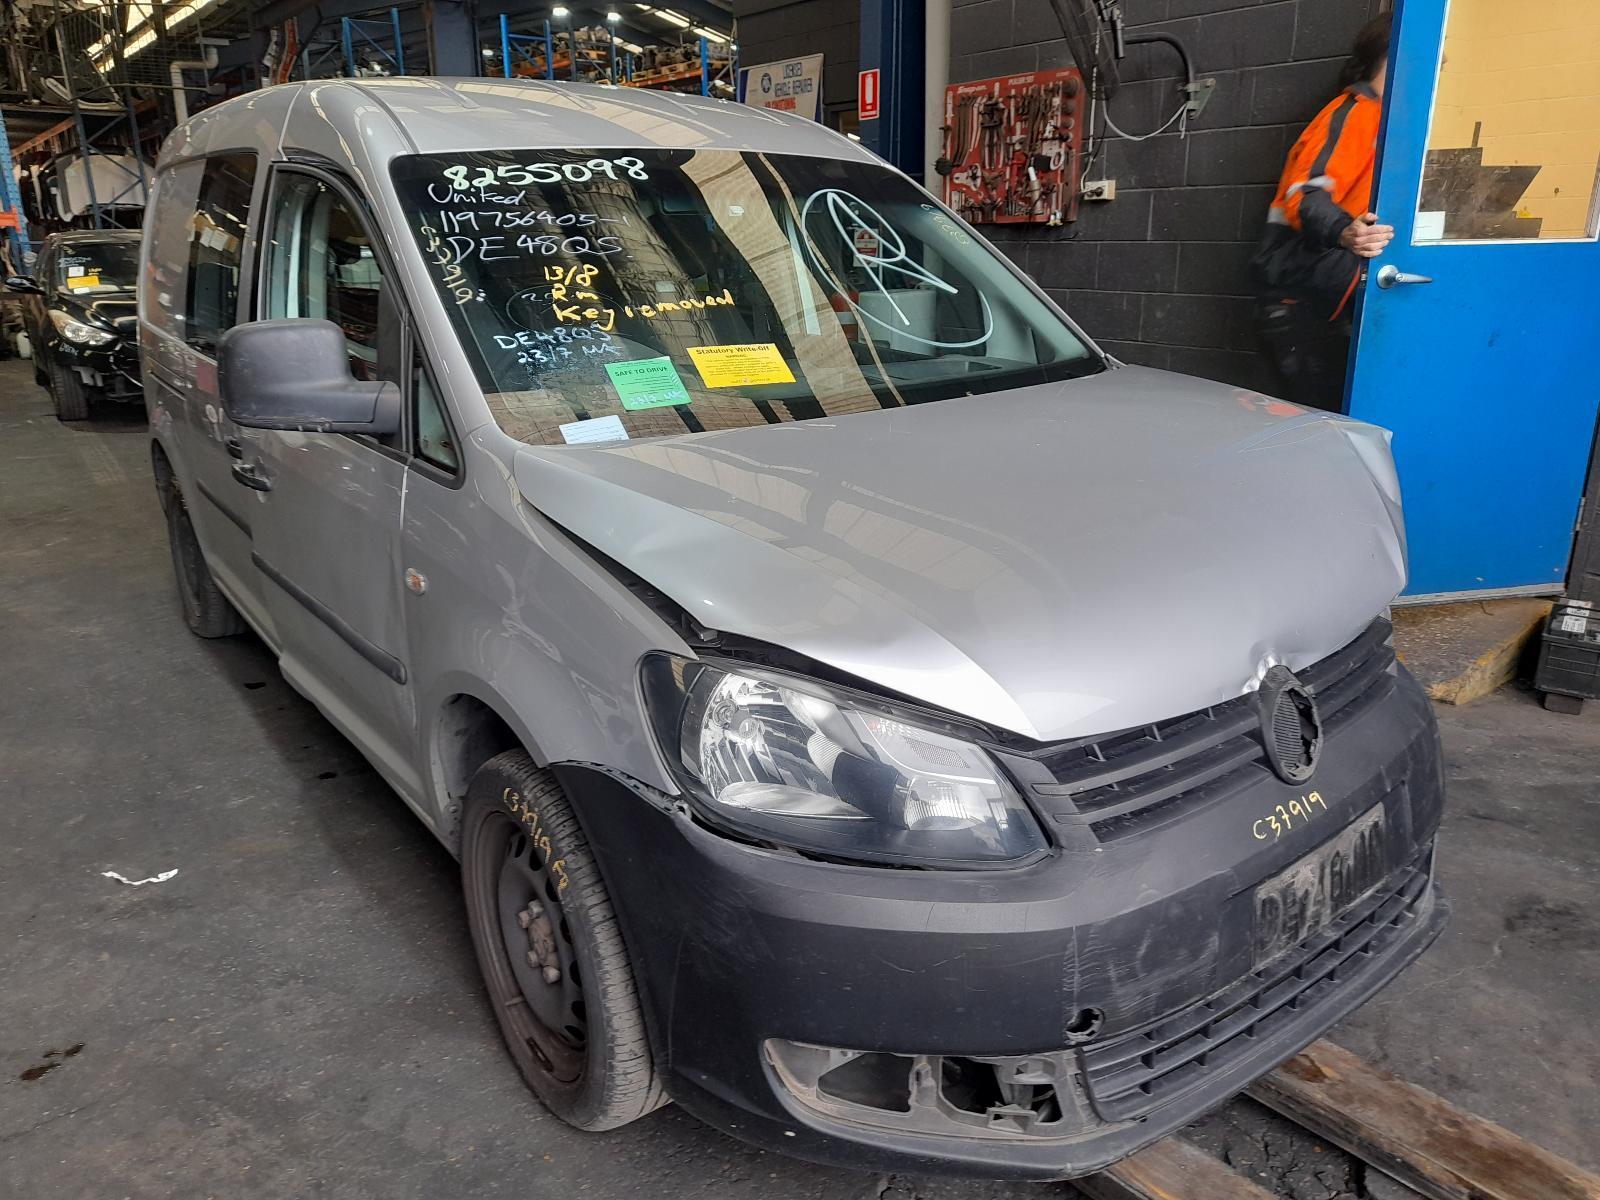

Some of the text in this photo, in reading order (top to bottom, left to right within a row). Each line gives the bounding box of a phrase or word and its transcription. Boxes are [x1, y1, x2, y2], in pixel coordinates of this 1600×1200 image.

[444, 156, 649, 191] 8255098
[427, 183, 526, 206] United
[544, 263, 599, 287] 13/8
[552, 288, 735, 332] Key removed
[736, 345, 770, 353] Write-Off
[614, 369, 633, 377] SAFE
[1253, 791, 1328, 840] C37919
